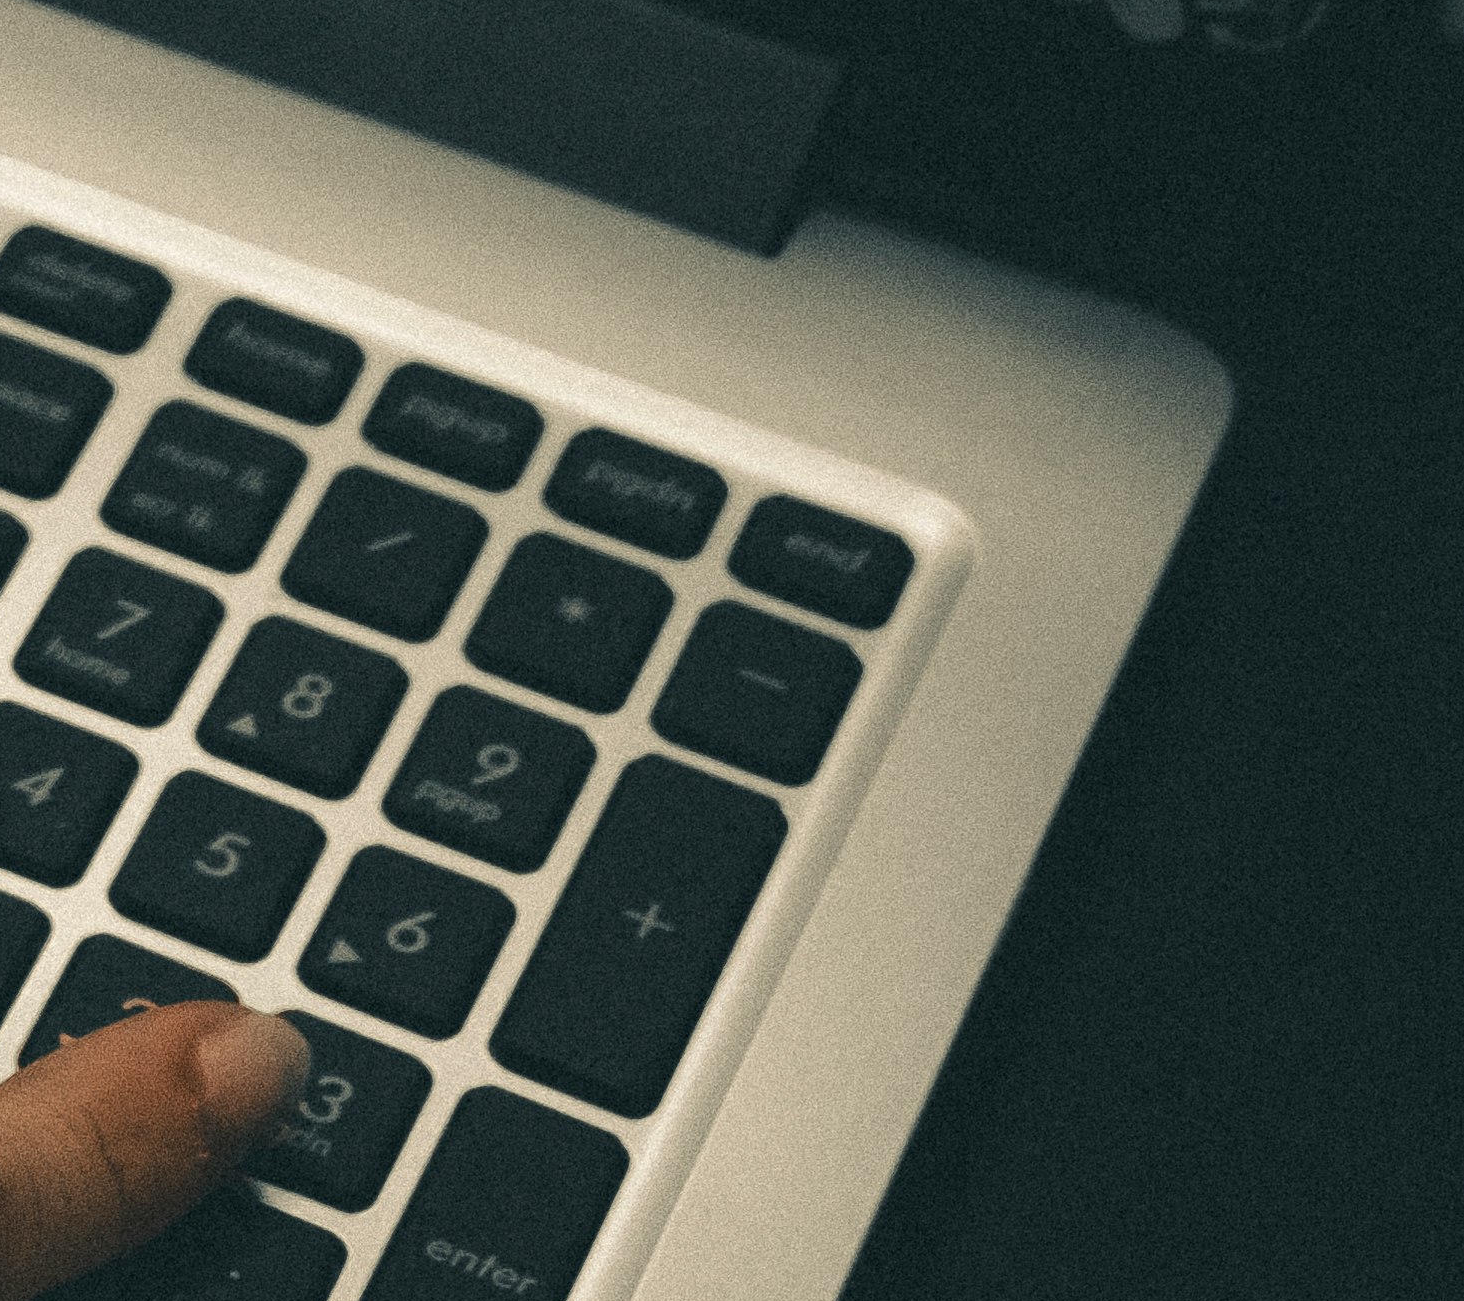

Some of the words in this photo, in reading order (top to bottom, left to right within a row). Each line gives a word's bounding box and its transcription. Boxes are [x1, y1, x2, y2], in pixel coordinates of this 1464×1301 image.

[98, 600, 150, 639] 7
[283, 675, 332, 718] 8
[472, 742, 521, 786] 9
[14, 768, 63, 804] 4
[196, 833, 249, 877] 5
[387, 913, 433, 952] 6
[296, 1073, 355, 1125] 3
[422, 1237, 540, 1297] enter
